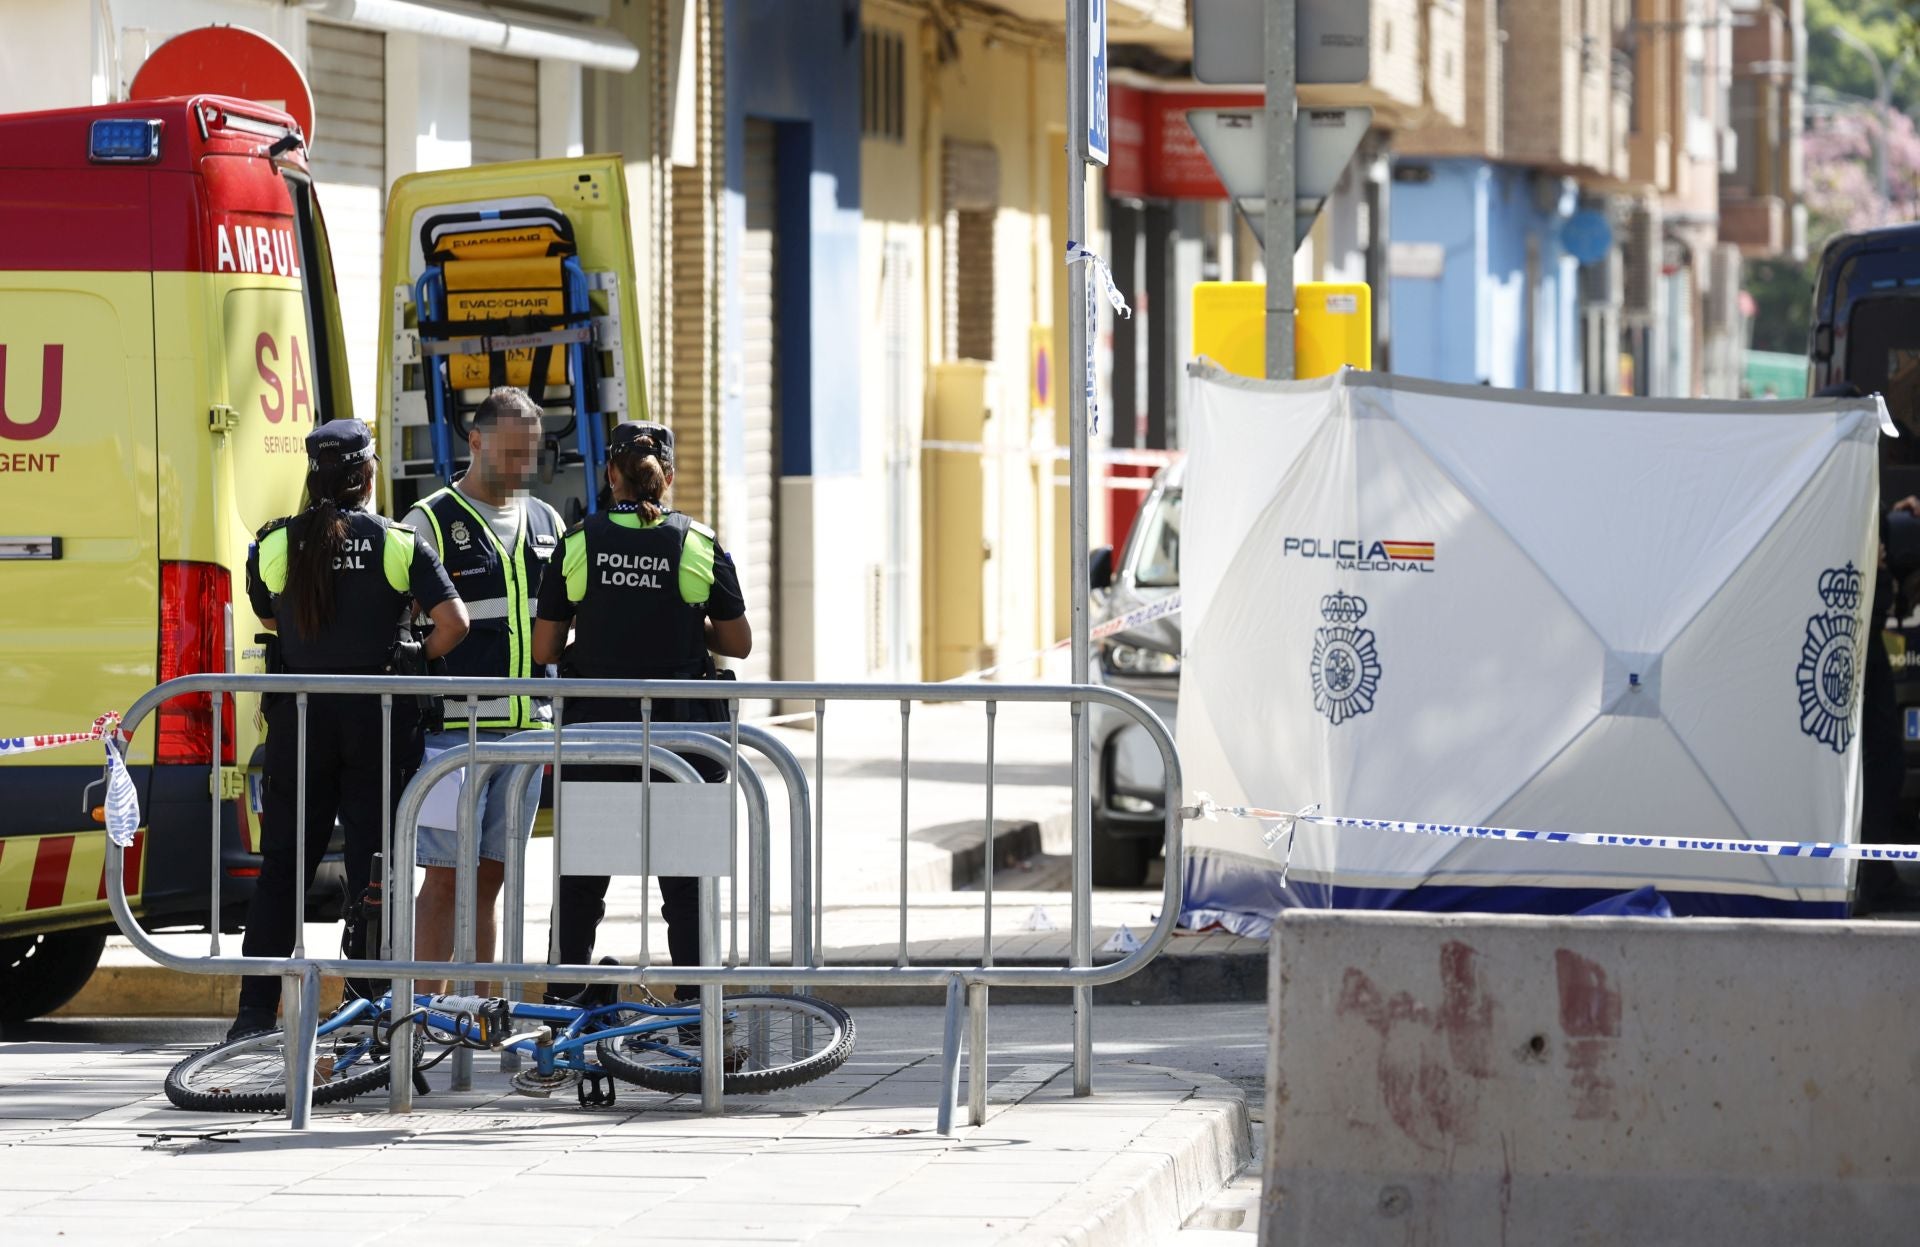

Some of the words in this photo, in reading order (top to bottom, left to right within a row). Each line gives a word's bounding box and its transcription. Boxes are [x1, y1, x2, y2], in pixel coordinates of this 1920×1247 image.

[596, 552, 671, 572] POLICIA
[1335, 560, 1435, 573] NACIONAL
[601, 570, 662, 589] LOCAL
